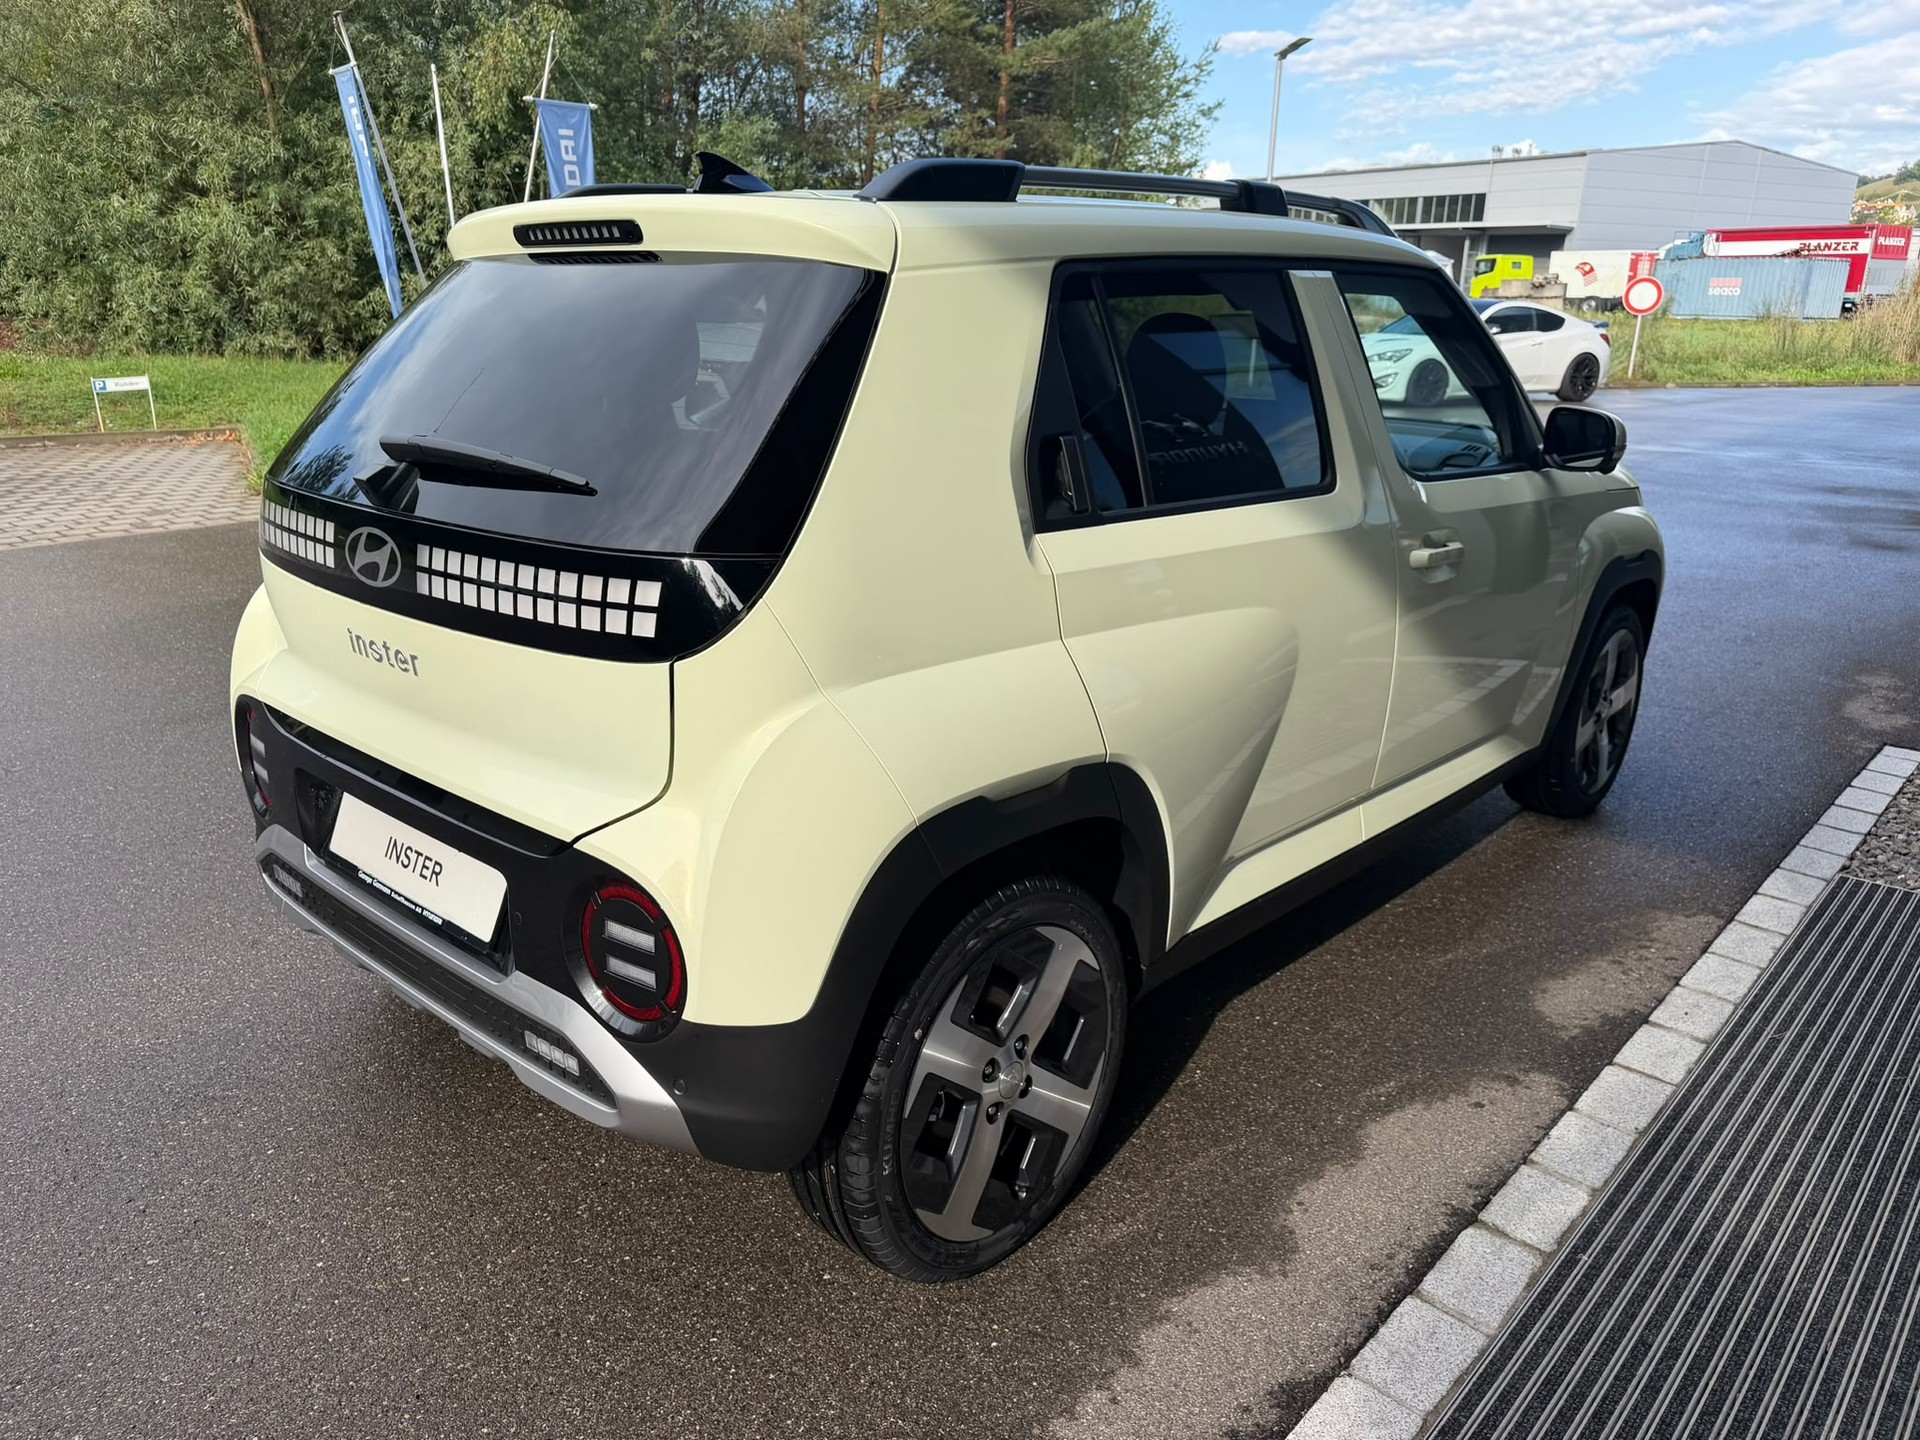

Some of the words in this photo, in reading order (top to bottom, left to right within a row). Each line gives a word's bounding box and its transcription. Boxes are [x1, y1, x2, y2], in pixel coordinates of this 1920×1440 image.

[1799, 241, 1859, 252] PLANZER
[1877, 236, 1905, 246] PLANZER
[1707, 286, 1741, 296] seaco
[95, 381, 104, 391] P
[347, 627, 419, 677] inster
[384, 835, 443, 887] INSTER
[882, 1088, 901, 1176] KUMHO
